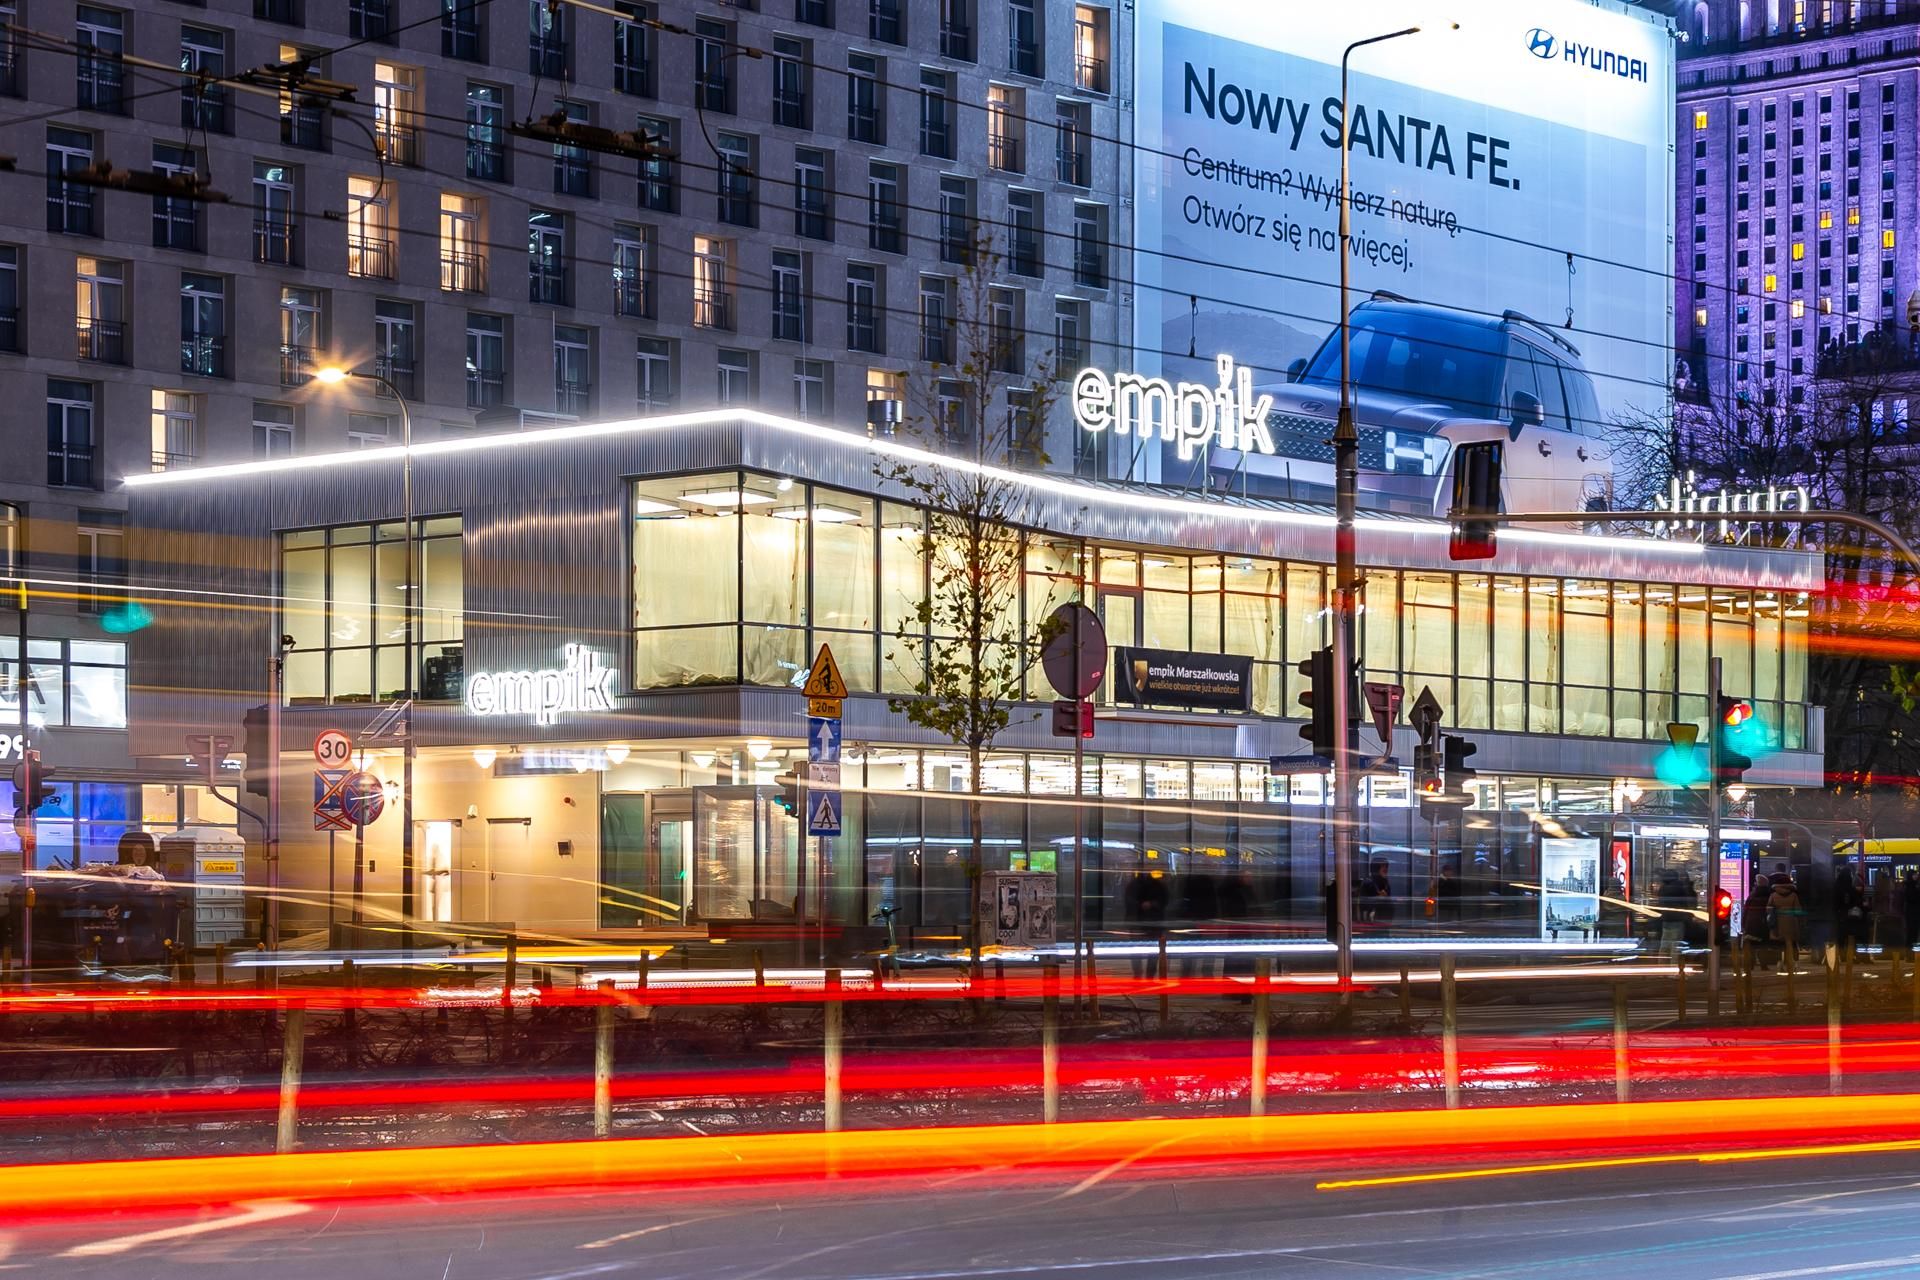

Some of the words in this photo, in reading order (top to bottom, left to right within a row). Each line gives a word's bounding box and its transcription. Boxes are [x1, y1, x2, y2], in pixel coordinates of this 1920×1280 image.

[1564, 40, 1647, 83] HYUNDAI
[1184, 62, 1309, 151] Nowy
[1320, 97, 1455, 176] SANTA
[1466, 131, 1521, 190] FE.
[1183, 147, 1293, 196] Centrum?
[1391, 198, 1461, 238] naturę.
[1183, 195, 1266, 239] Otwórz
[1272, 214, 1302, 252] się
[1308, 229, 1336, 253] na
[1347, 230, 1414, 272] więcej.
[1072, 354, 1275, 460] empik
[467, 643, 621, 725] empik
[1149, 664, 1175, 678] empik
[1176, 666, 1239, 682] Marszałkowska
[1173, 683, 1200, 692] otwarcie
[320, 740, 347, 759] 30
